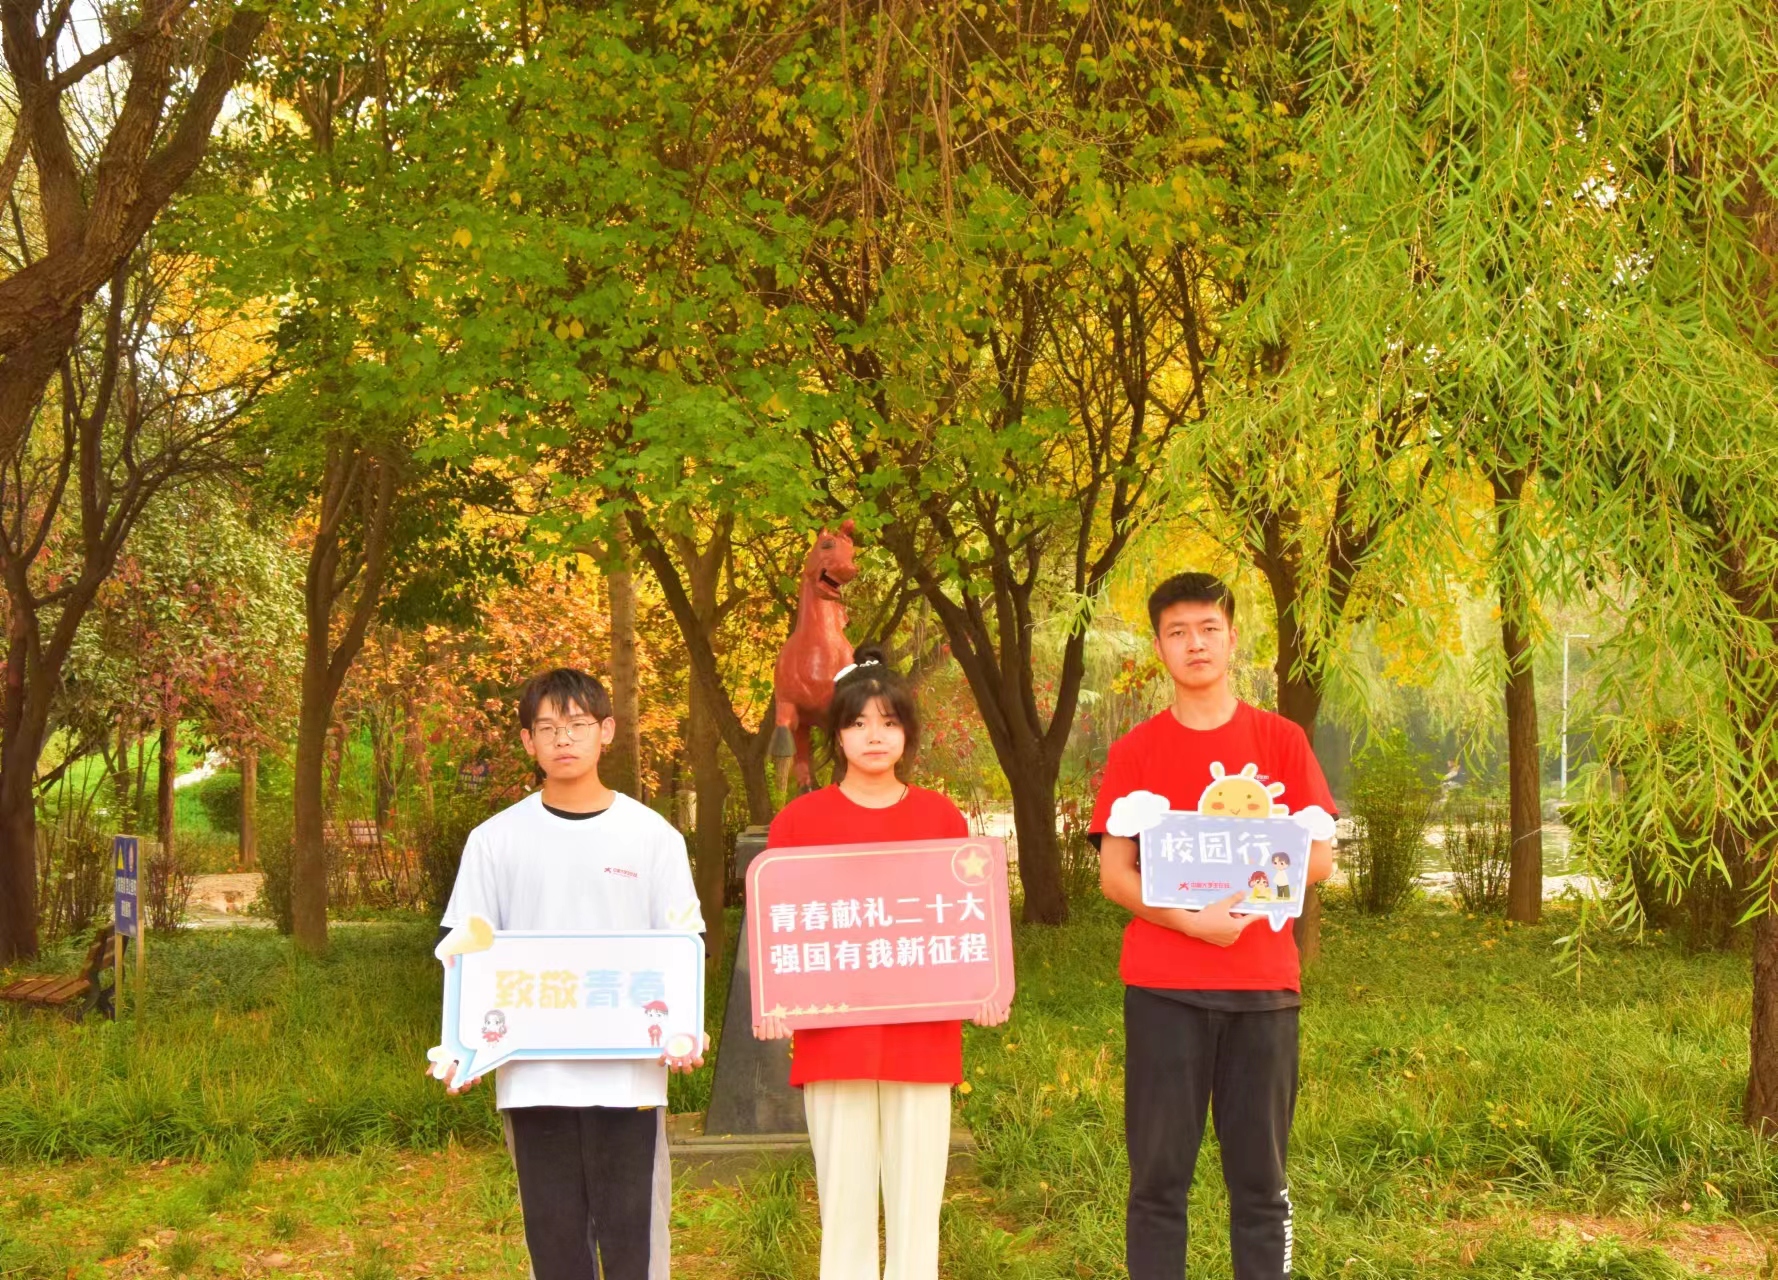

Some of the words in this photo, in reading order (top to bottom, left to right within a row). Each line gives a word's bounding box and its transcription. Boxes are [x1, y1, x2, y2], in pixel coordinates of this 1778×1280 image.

[1160, 830, 1272, 867] 校园行
[768, 892, 985, 933] 青春献礼二十大
[769, 933, 990, 974] 强国有我新征程
[494, 969, 665, 1009] 致敬青春
